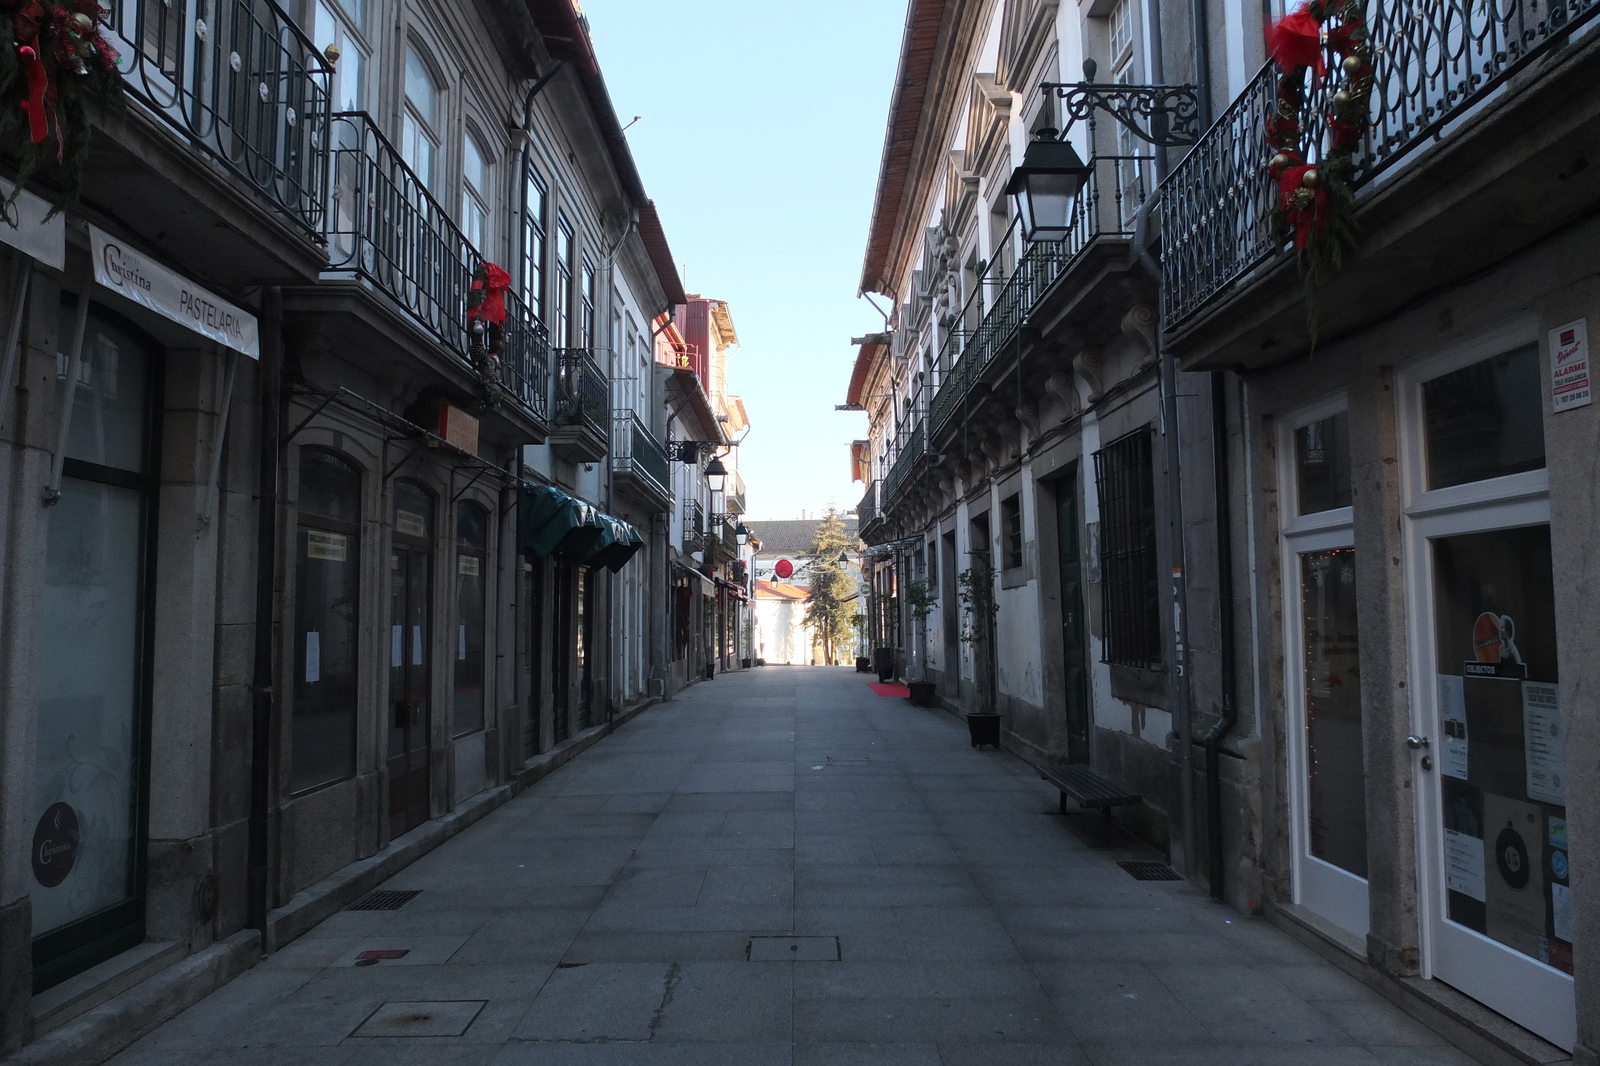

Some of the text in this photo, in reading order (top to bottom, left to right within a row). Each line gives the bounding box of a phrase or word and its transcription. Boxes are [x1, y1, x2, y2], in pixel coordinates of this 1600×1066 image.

[103, 243, 151, 292] Christina
[179, 289, 244, 341] PASTELARIA
[1553, 361, 1587, 379] ALARME
[1466, 664, 1496, 674] OBJECTOS
